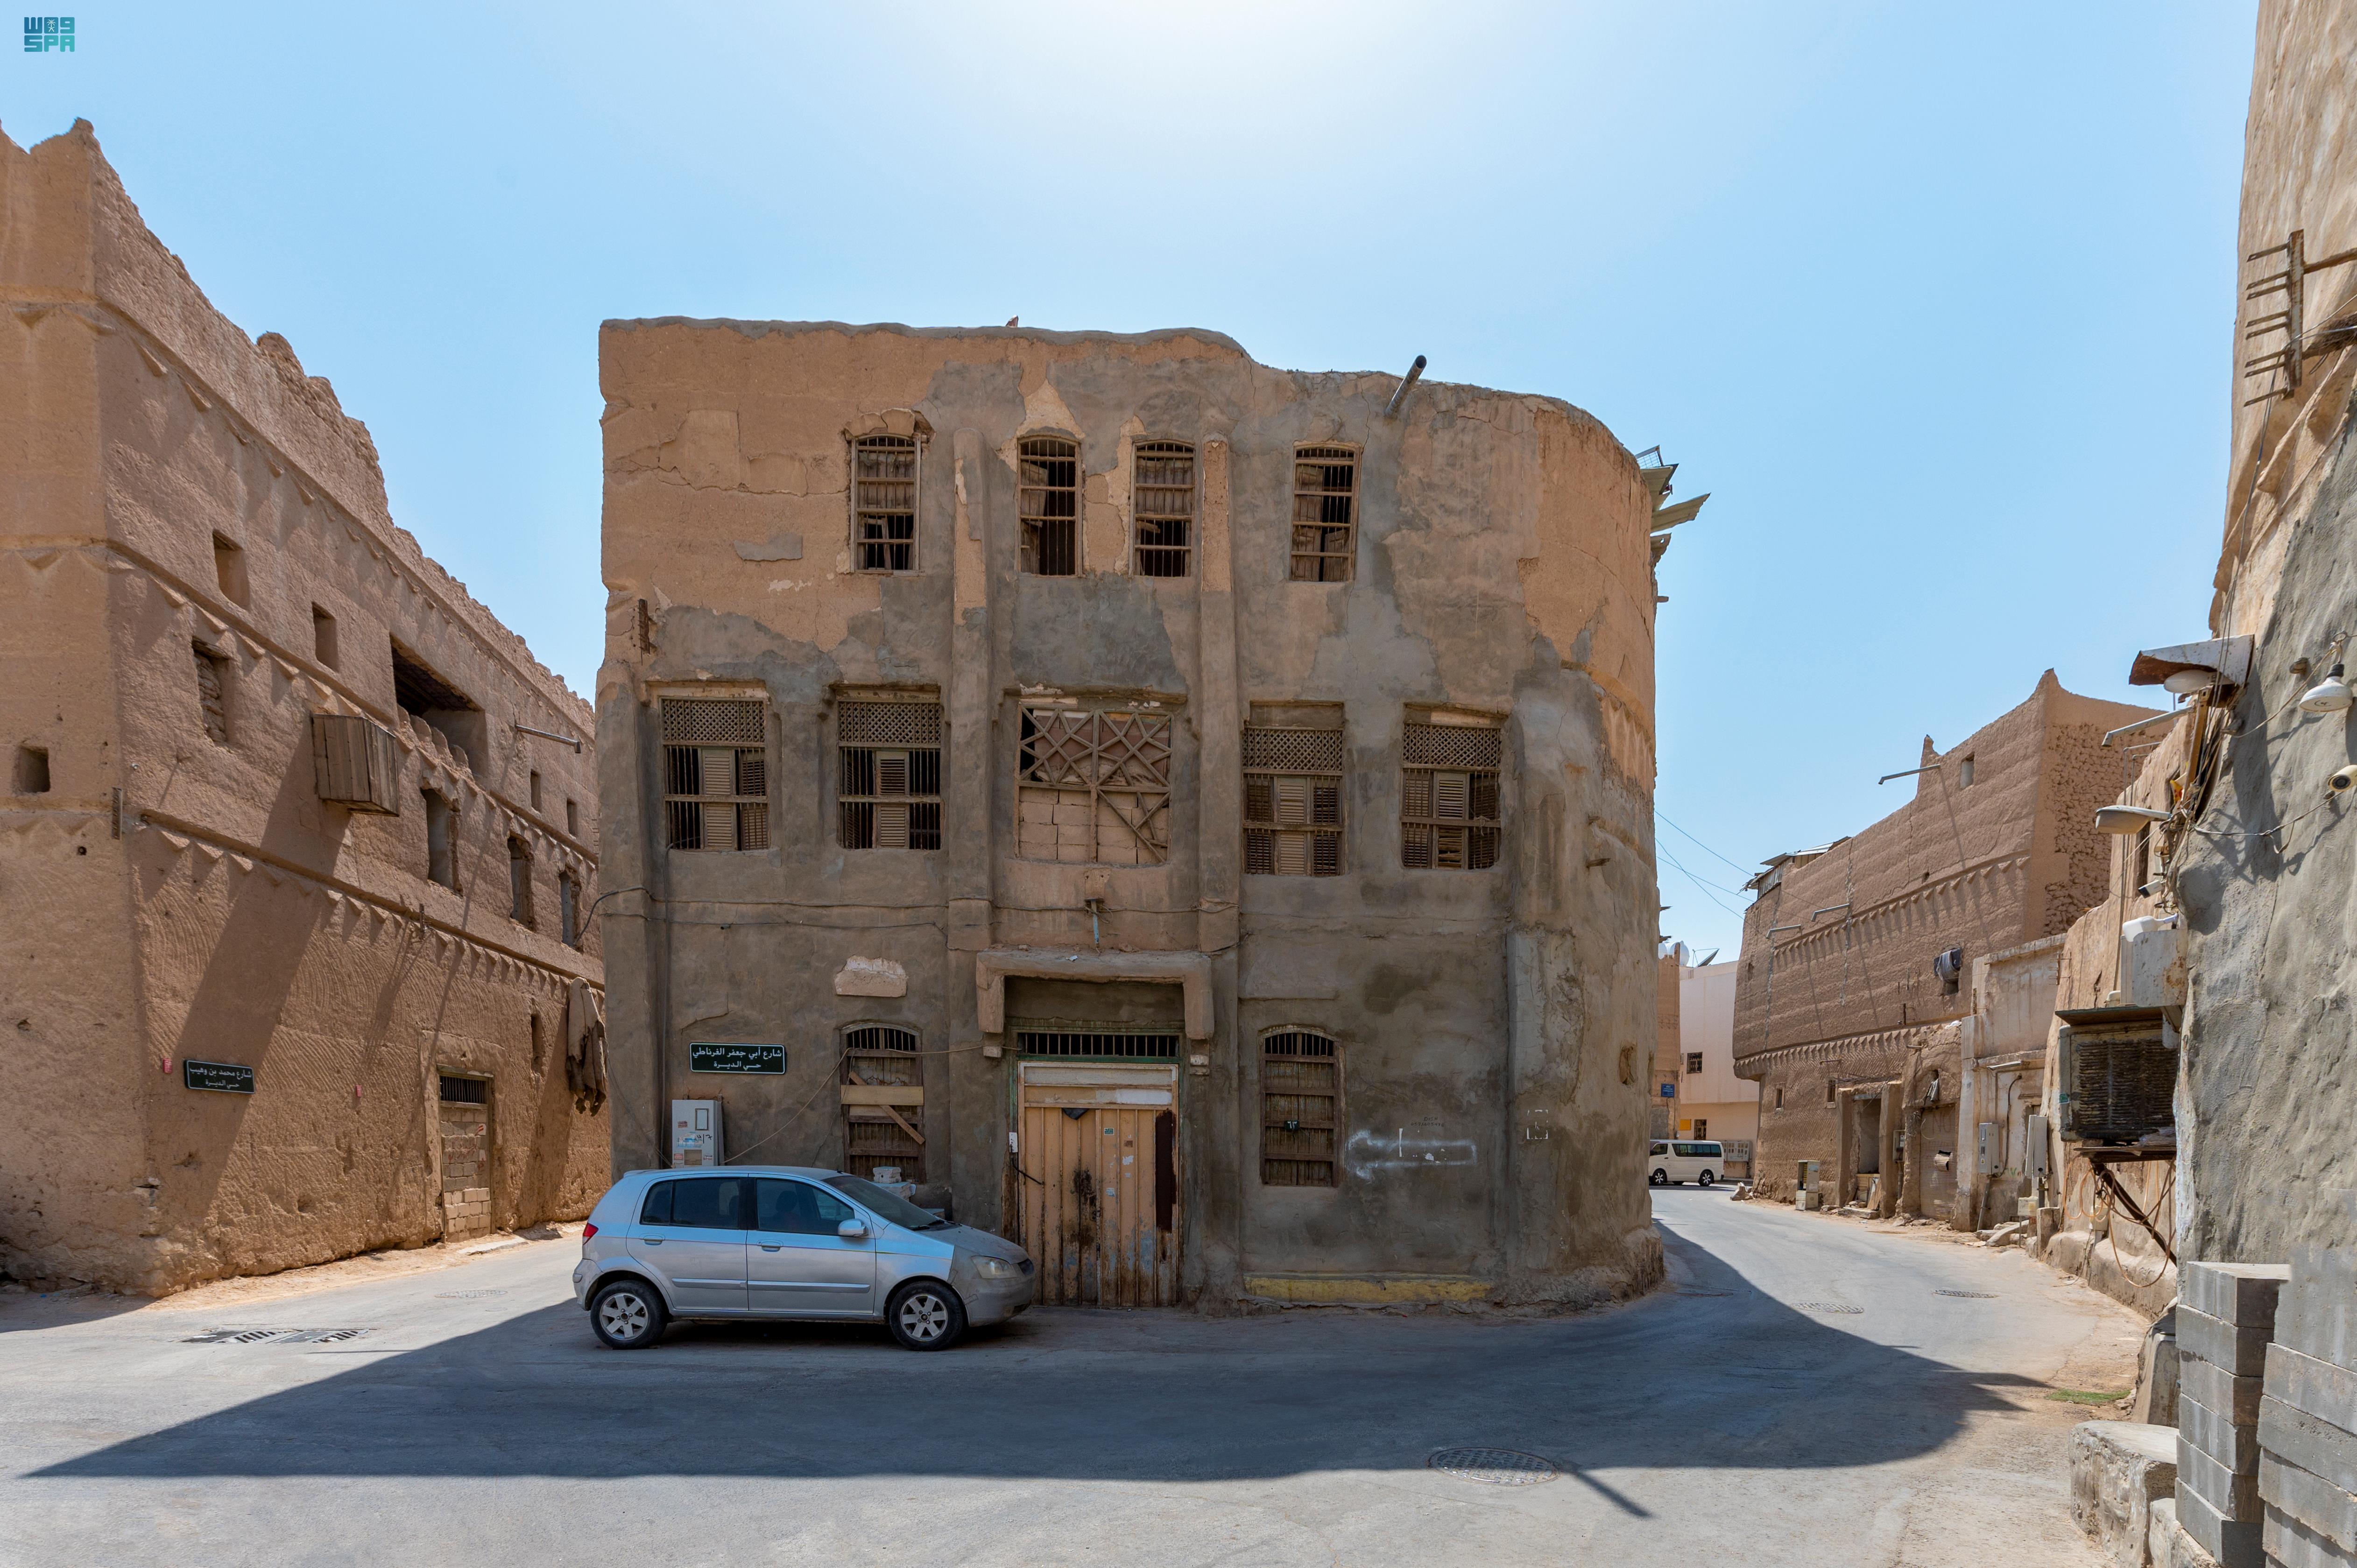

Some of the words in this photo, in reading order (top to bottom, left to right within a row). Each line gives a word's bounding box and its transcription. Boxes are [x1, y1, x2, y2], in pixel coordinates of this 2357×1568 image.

[692, 1047, 725, 1057] الغرناطي
[727, 1049, 746, 1058] جعفر
[748, 1047, 761, 1060] أبي
[763, 1048, 782, 1060] شارع
[190, 1067, 207, 1075] وهيب
[236, 1069, 252, 1080] شارع
